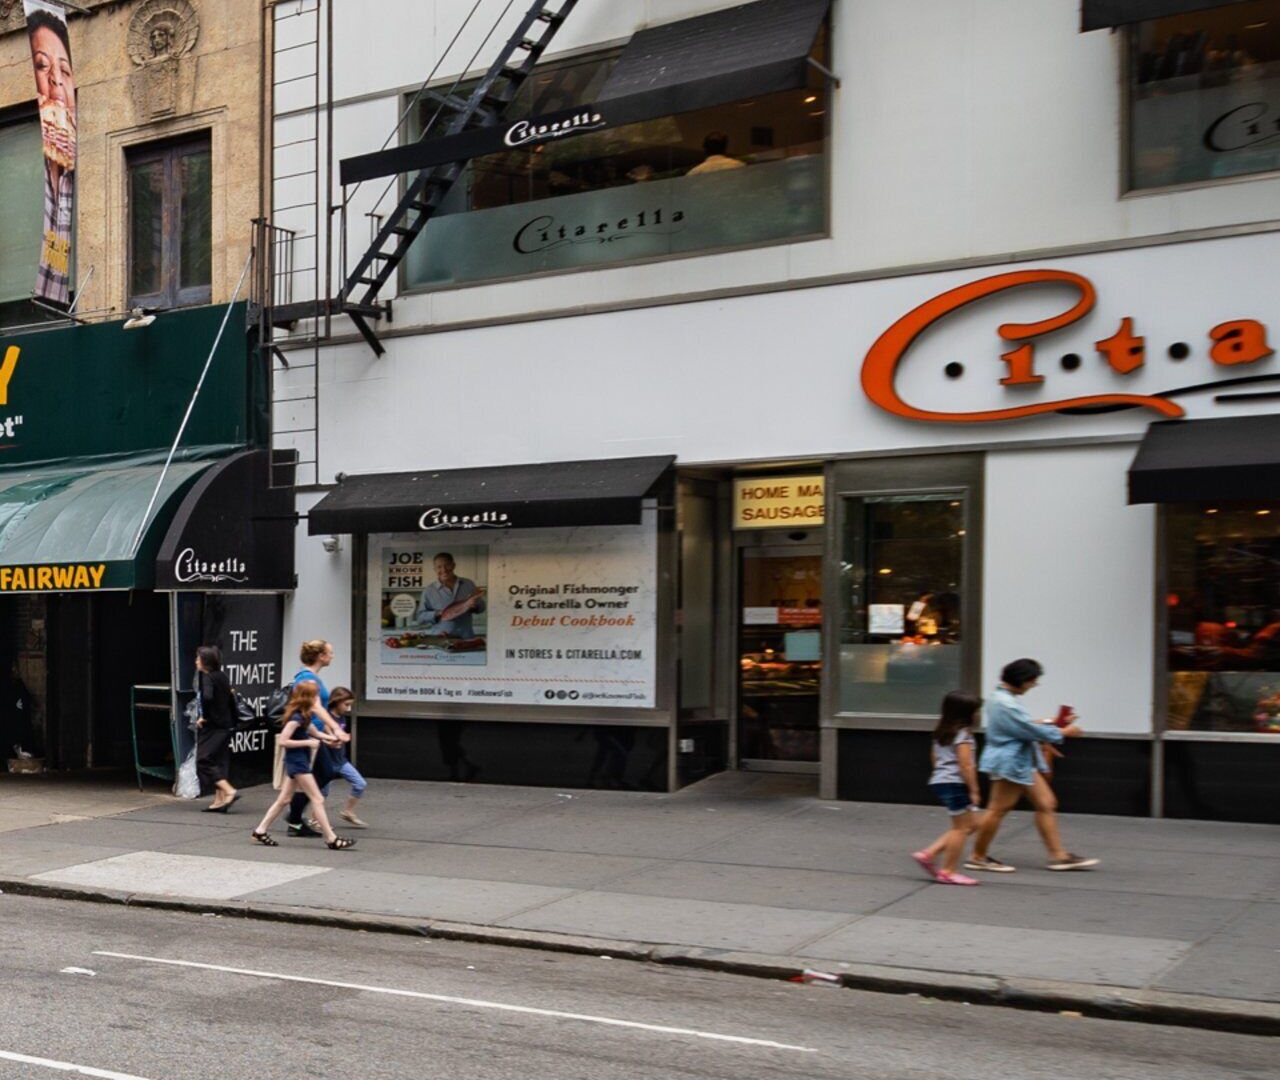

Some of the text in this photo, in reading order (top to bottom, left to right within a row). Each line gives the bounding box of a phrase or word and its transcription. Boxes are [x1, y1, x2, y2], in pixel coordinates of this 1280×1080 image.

[504, 113, 601, 146] Citarella
[513, 209, 685, 254] Citarella
[741, 484, 824, 500] HOME MA
[419, 507, 508, 530] Citarella
[741, 505, 825, 520] SAUSAGE
[175, 548, 246, 582] Citarella
[389, 552, 423, 564] JOE
[0, 564, 106, 590] FAIRWAY
[388, 576, 423, 587] FISH
[508, 584, 639, 597] Original Fishmonger
[514, 599, 629, 609] & Citarella Owner
[511, 614, 636, 626] Debut Cookbook
[230, 630, 258, 651] THE
[505, 649, 642, 659] IN STORES & CITARELLA.COM
[222, 663, 275, 685] TIMATE
[420, 687, 435, 695] BOOK
